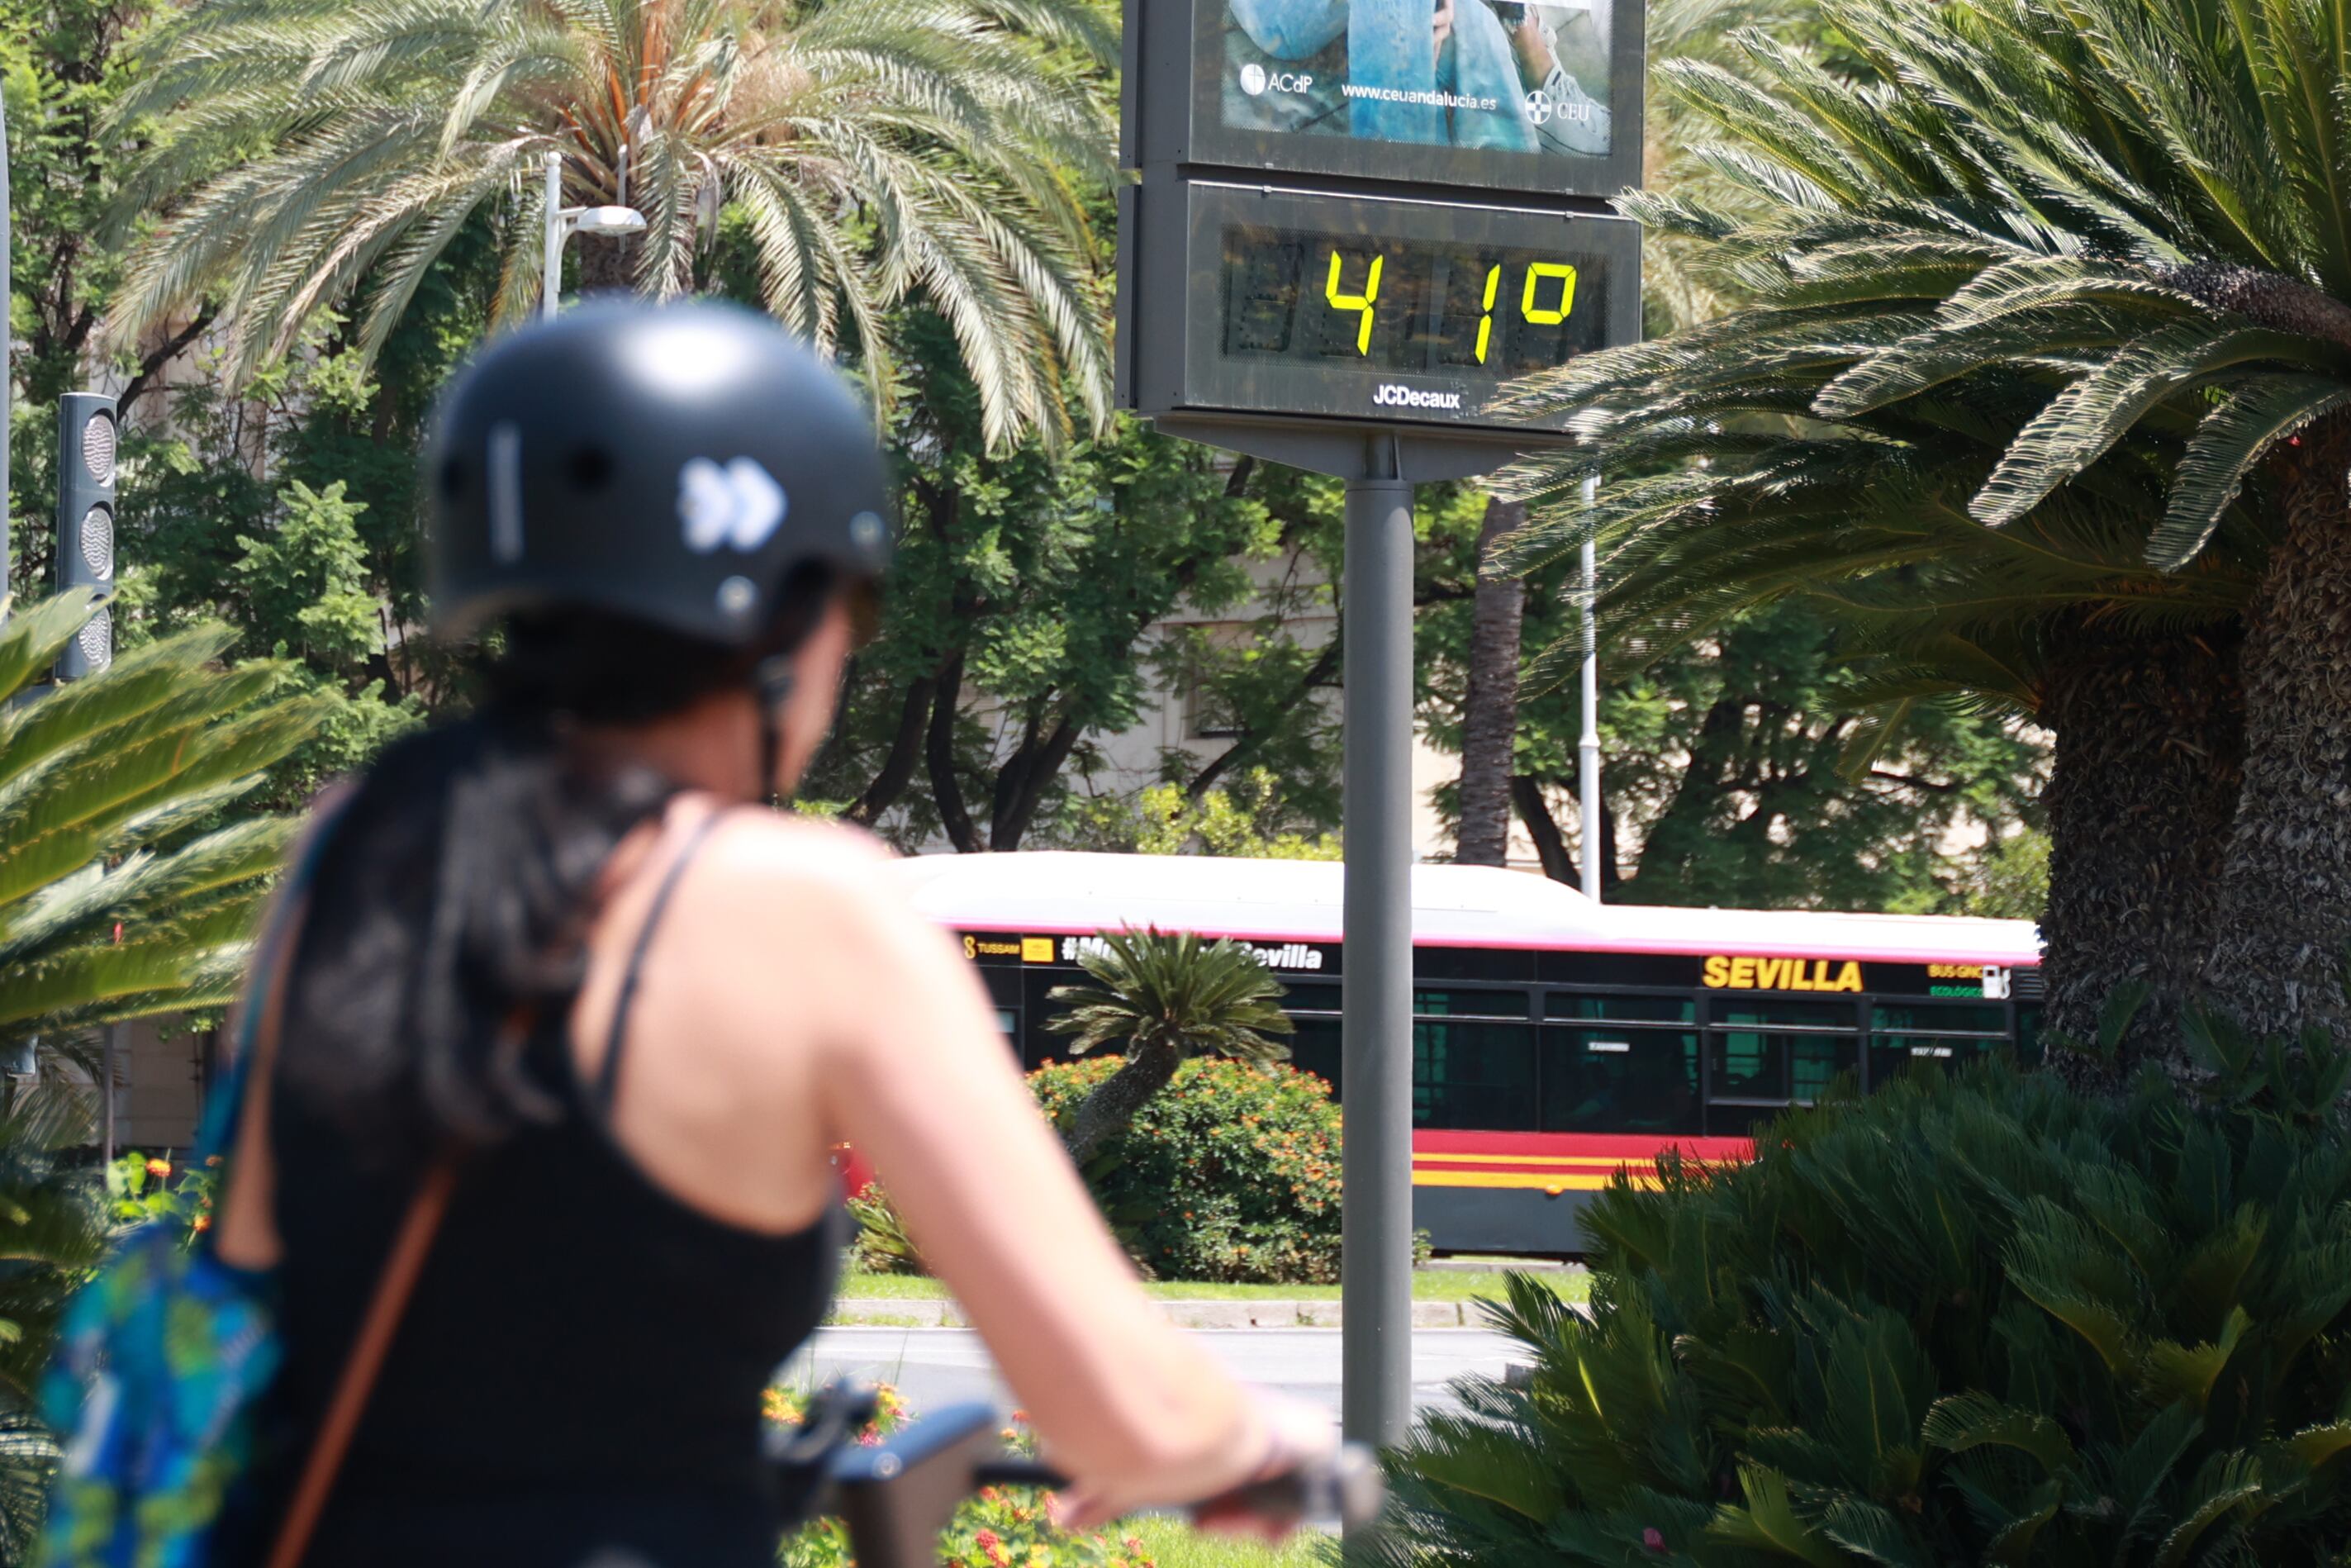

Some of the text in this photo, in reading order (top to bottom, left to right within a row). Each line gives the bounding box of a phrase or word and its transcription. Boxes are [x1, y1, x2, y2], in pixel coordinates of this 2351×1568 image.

[1268, 73, 1313, 94] ACdP
[1342, 84, 1497, 111] www.ceuandalucia.es
[1557, 102, 1590, 121] CEU
[1373, 384, 1460, 409] JCDecaux
[977, 943, 1021, 954] TUSSAM
[1703, 956, 1863, 993] SEVILLA
[1928, 964, 1955, 978] BUS
